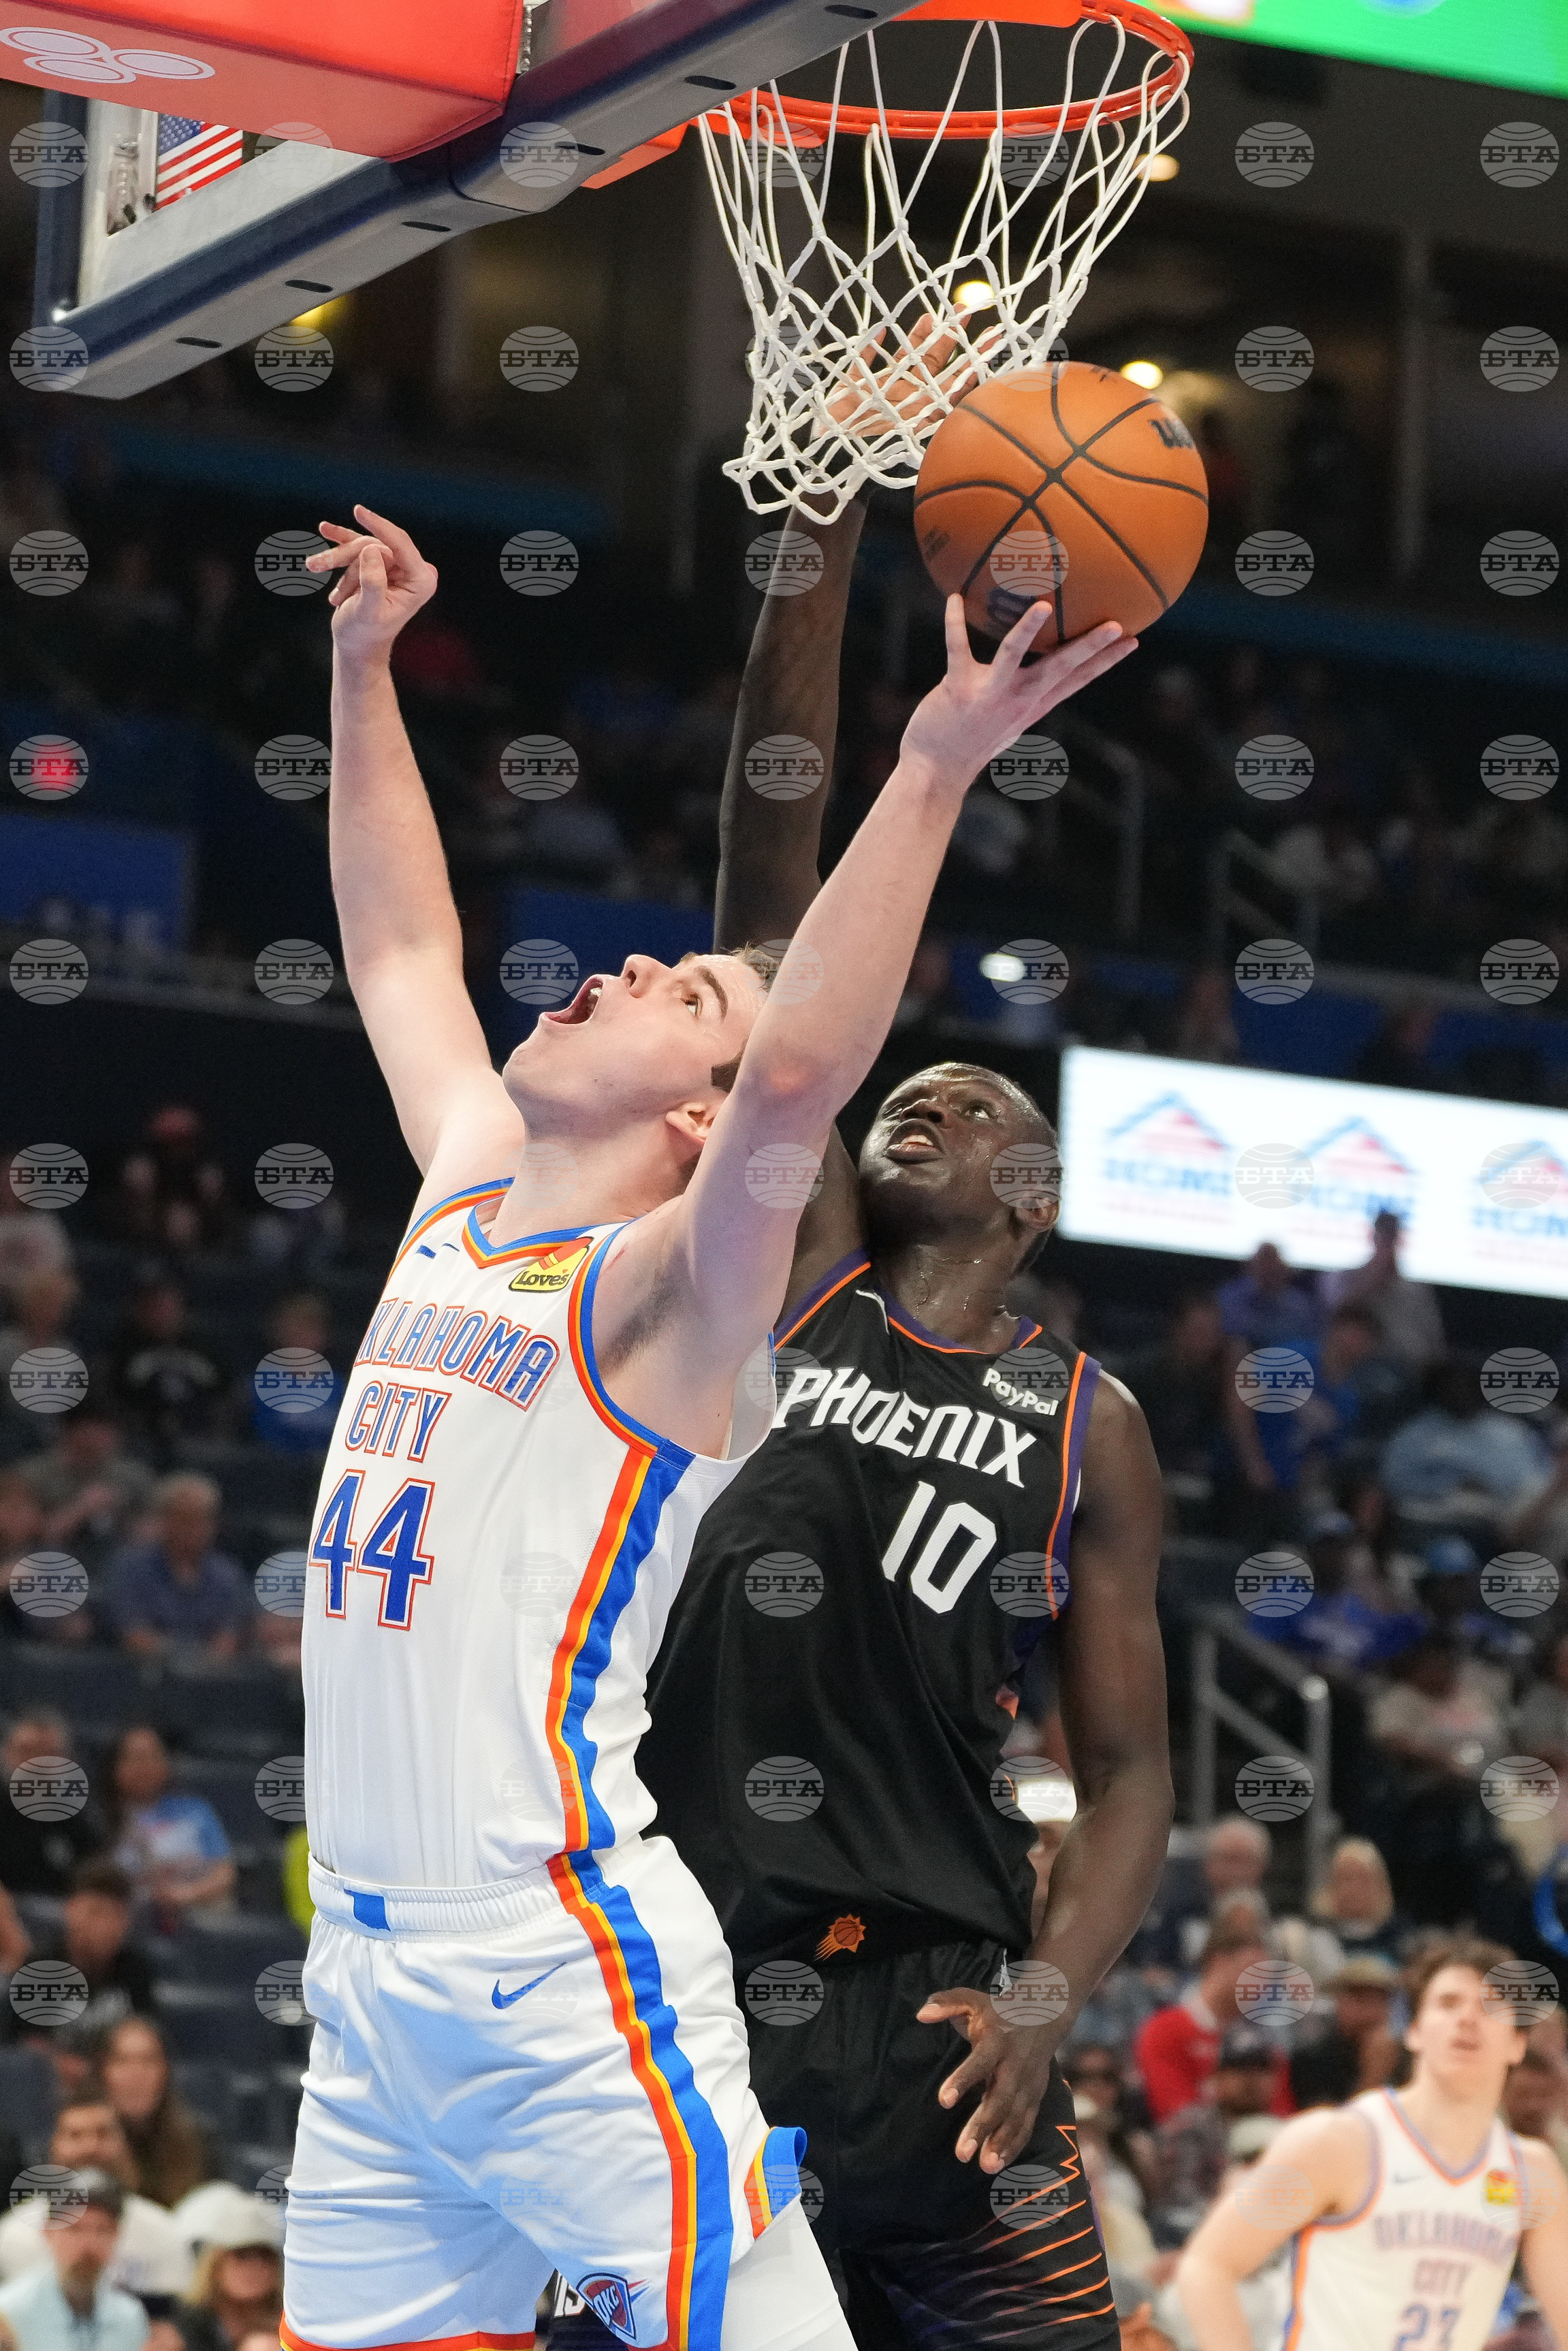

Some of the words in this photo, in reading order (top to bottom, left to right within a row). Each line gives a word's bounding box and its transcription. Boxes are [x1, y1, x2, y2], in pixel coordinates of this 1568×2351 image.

[354, 1297, 560, 1412] KLAHOMA
[982, 1368, 1059, 1416] PayPal
[345, 1380, 453, 1463] CITY
[771, 1366, 1037, 1489] PHOENIX
[310, 1469, 435, 1631] 44
[882, 1480, 997, 1614] 10
[592, 2284, 620, 2326] OKC
